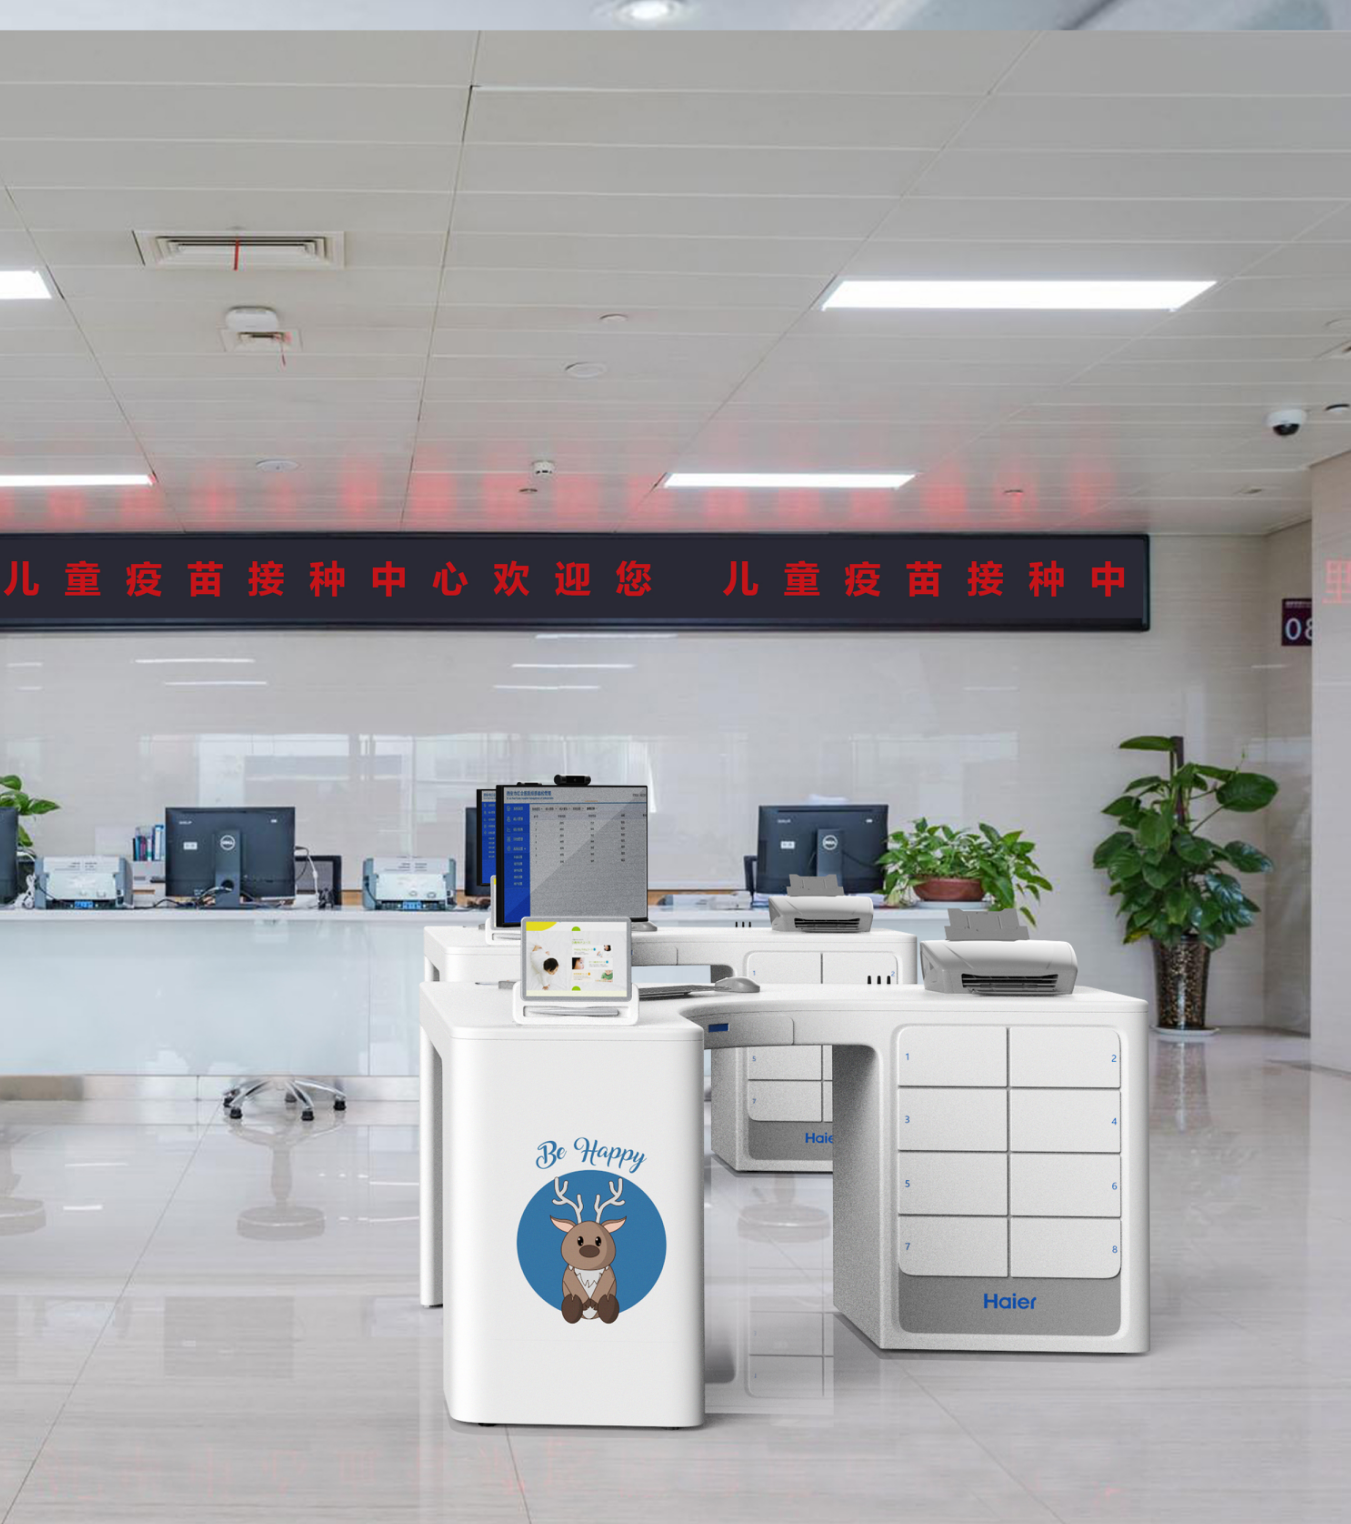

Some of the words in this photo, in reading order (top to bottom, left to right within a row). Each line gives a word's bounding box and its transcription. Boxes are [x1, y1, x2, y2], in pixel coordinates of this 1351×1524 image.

[804, 1131, 833, 1144] Haie
[535, 1140, 567, 1170] Be
[573, 1136, 648, 1174] Happy
[983, 1292, 1038, 1310] Haier
